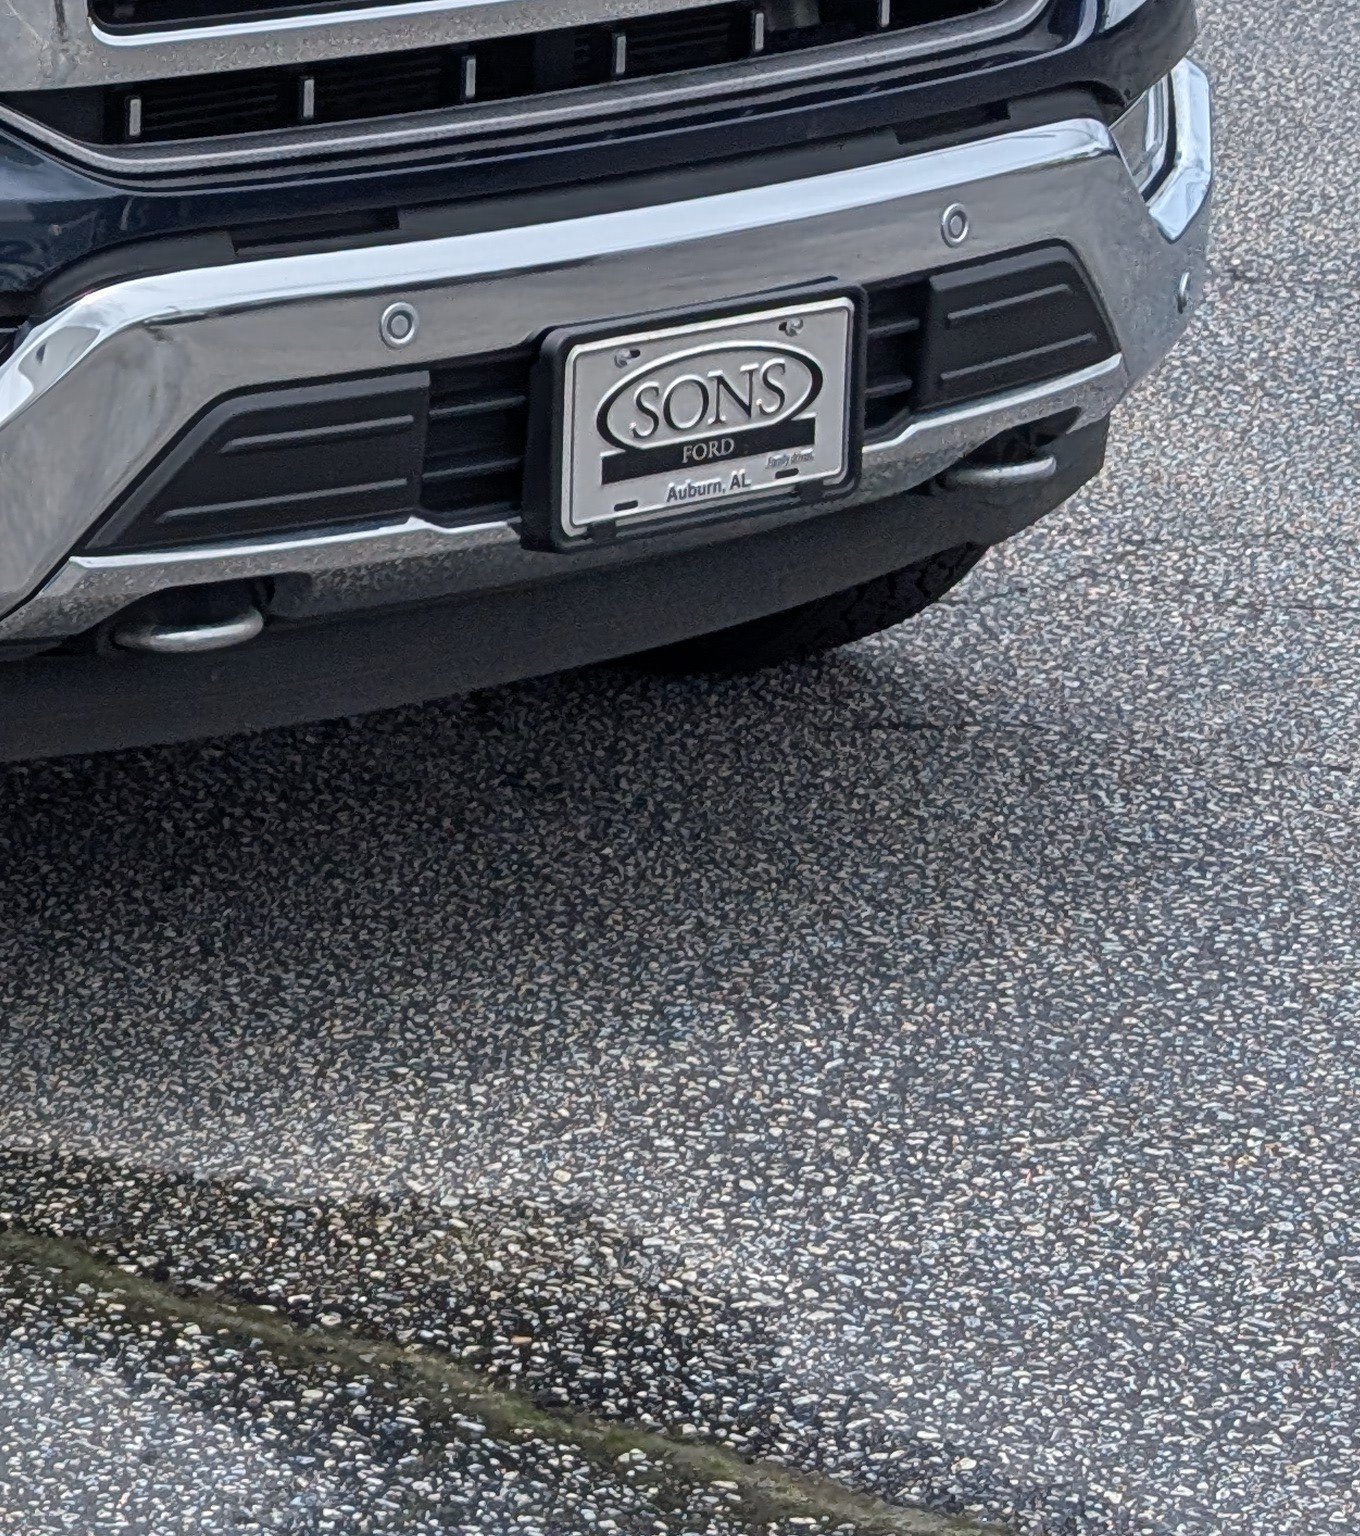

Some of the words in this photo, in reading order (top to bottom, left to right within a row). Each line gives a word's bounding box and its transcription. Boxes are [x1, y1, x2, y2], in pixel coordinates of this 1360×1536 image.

[630, 358, 786, 438] SONS
[682, 438, 735, 463] FORD
[666, 480, 726, 502] Auburn,
[730, 469, 751, 490] AL
